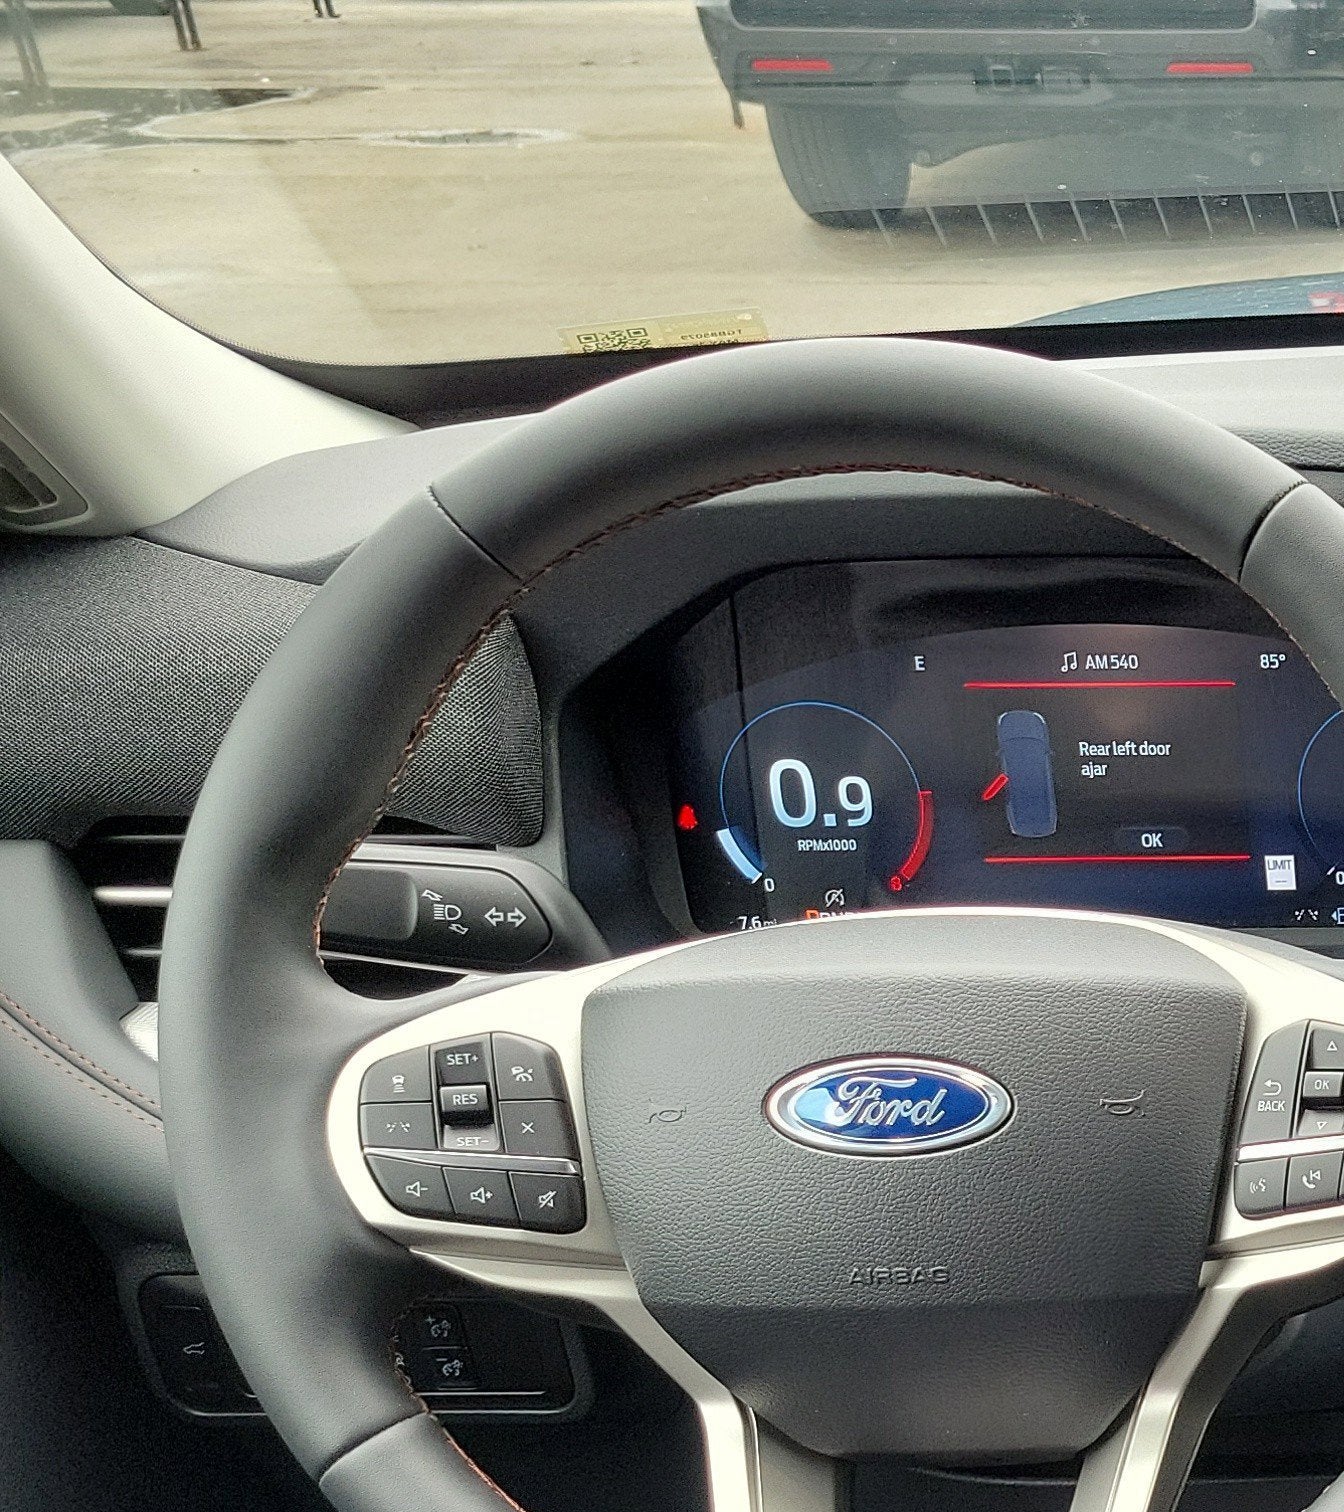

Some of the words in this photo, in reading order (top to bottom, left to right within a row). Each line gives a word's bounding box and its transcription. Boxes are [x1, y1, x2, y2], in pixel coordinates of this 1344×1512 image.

[914, 656, 926, 671] E
[1260, 653, 1286, 669] 85°
[1078, 741, 1110, 756] Rear
[1112, 741, 1132, 756] left
[1134, 741, 1171, 756] door
[1081, 761, 1108, 778] ajar
[768, 758, 874, 828] 0.9
[1141, 832, 1164, 848] OK
[763, 878, 775, 893] 0
[1314, 1079, 1330, 1090] OK
[452, 1093, 478, 1105] RES
[824, 1075, 946, 1128] Ford
[1257, 1100, 1285, 1112] BACK
[848, 1265, 950, 1286] AIRBAG
